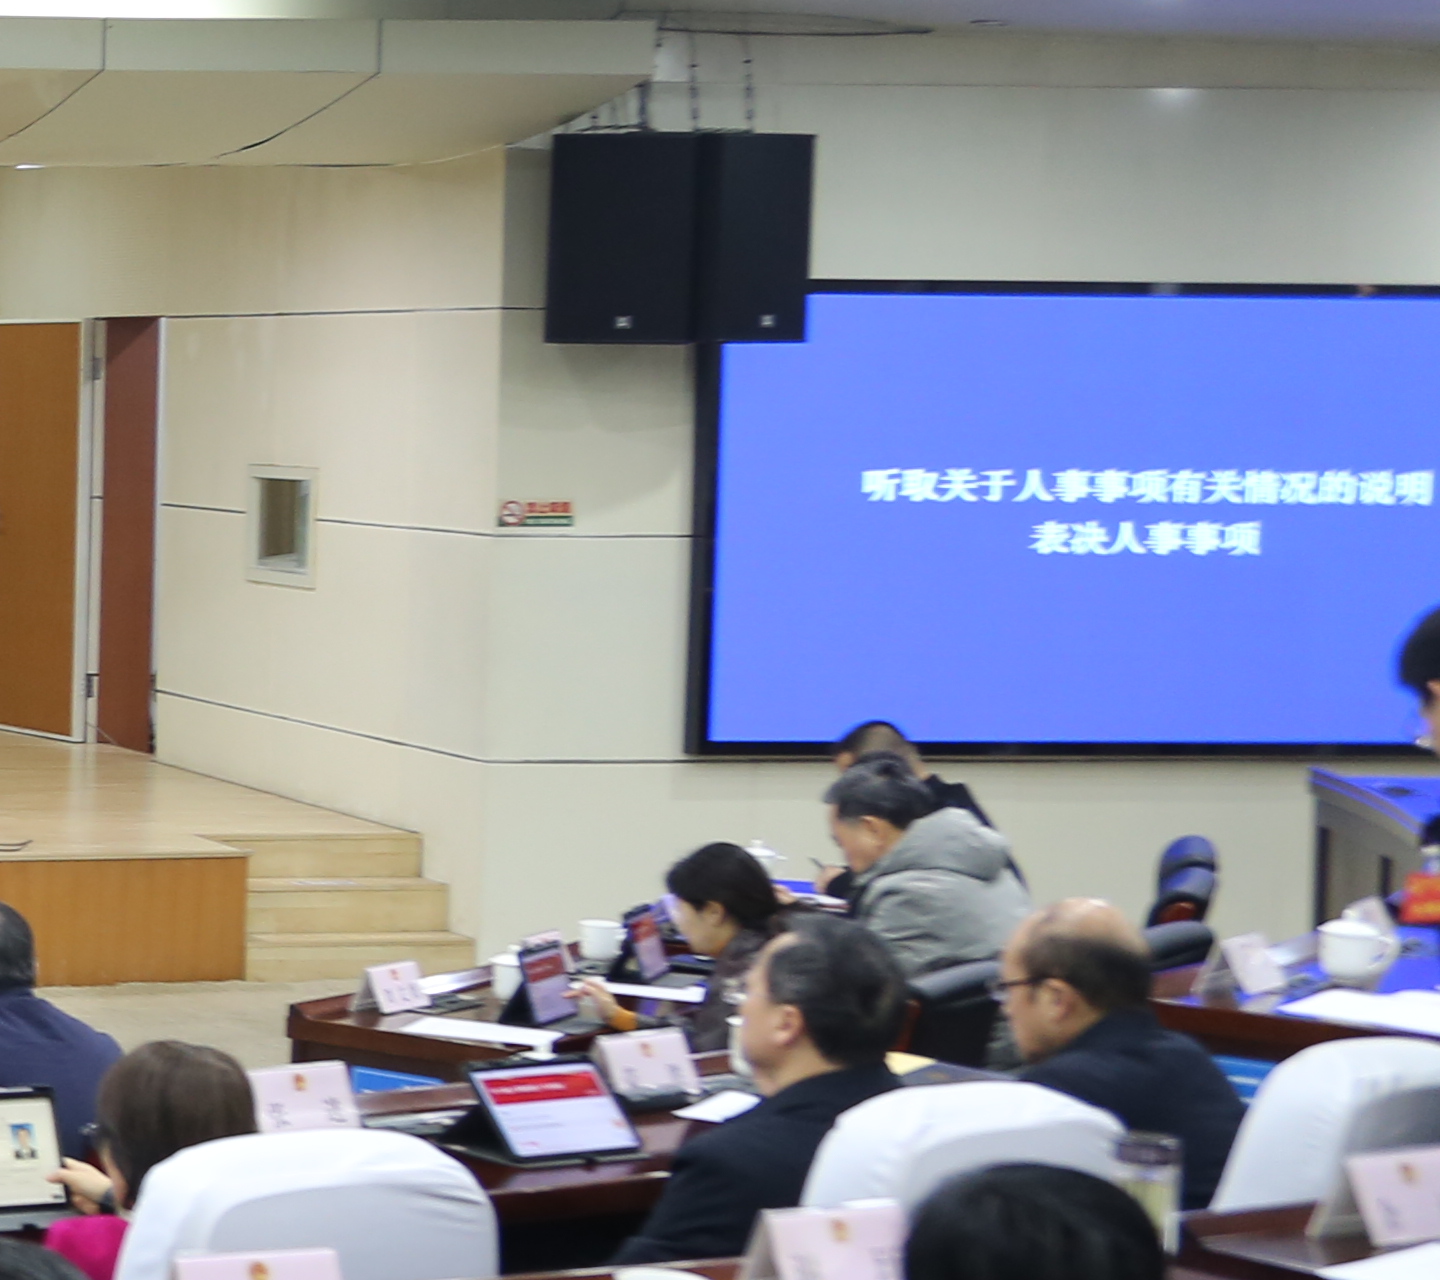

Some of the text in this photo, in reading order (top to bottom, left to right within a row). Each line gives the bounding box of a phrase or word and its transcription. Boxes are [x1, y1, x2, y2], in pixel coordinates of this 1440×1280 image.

[861, 468, 1435, 507] 听取关于人事事项有关情况的说明
[1029, 520, 1262, 556] 表决人事事项
